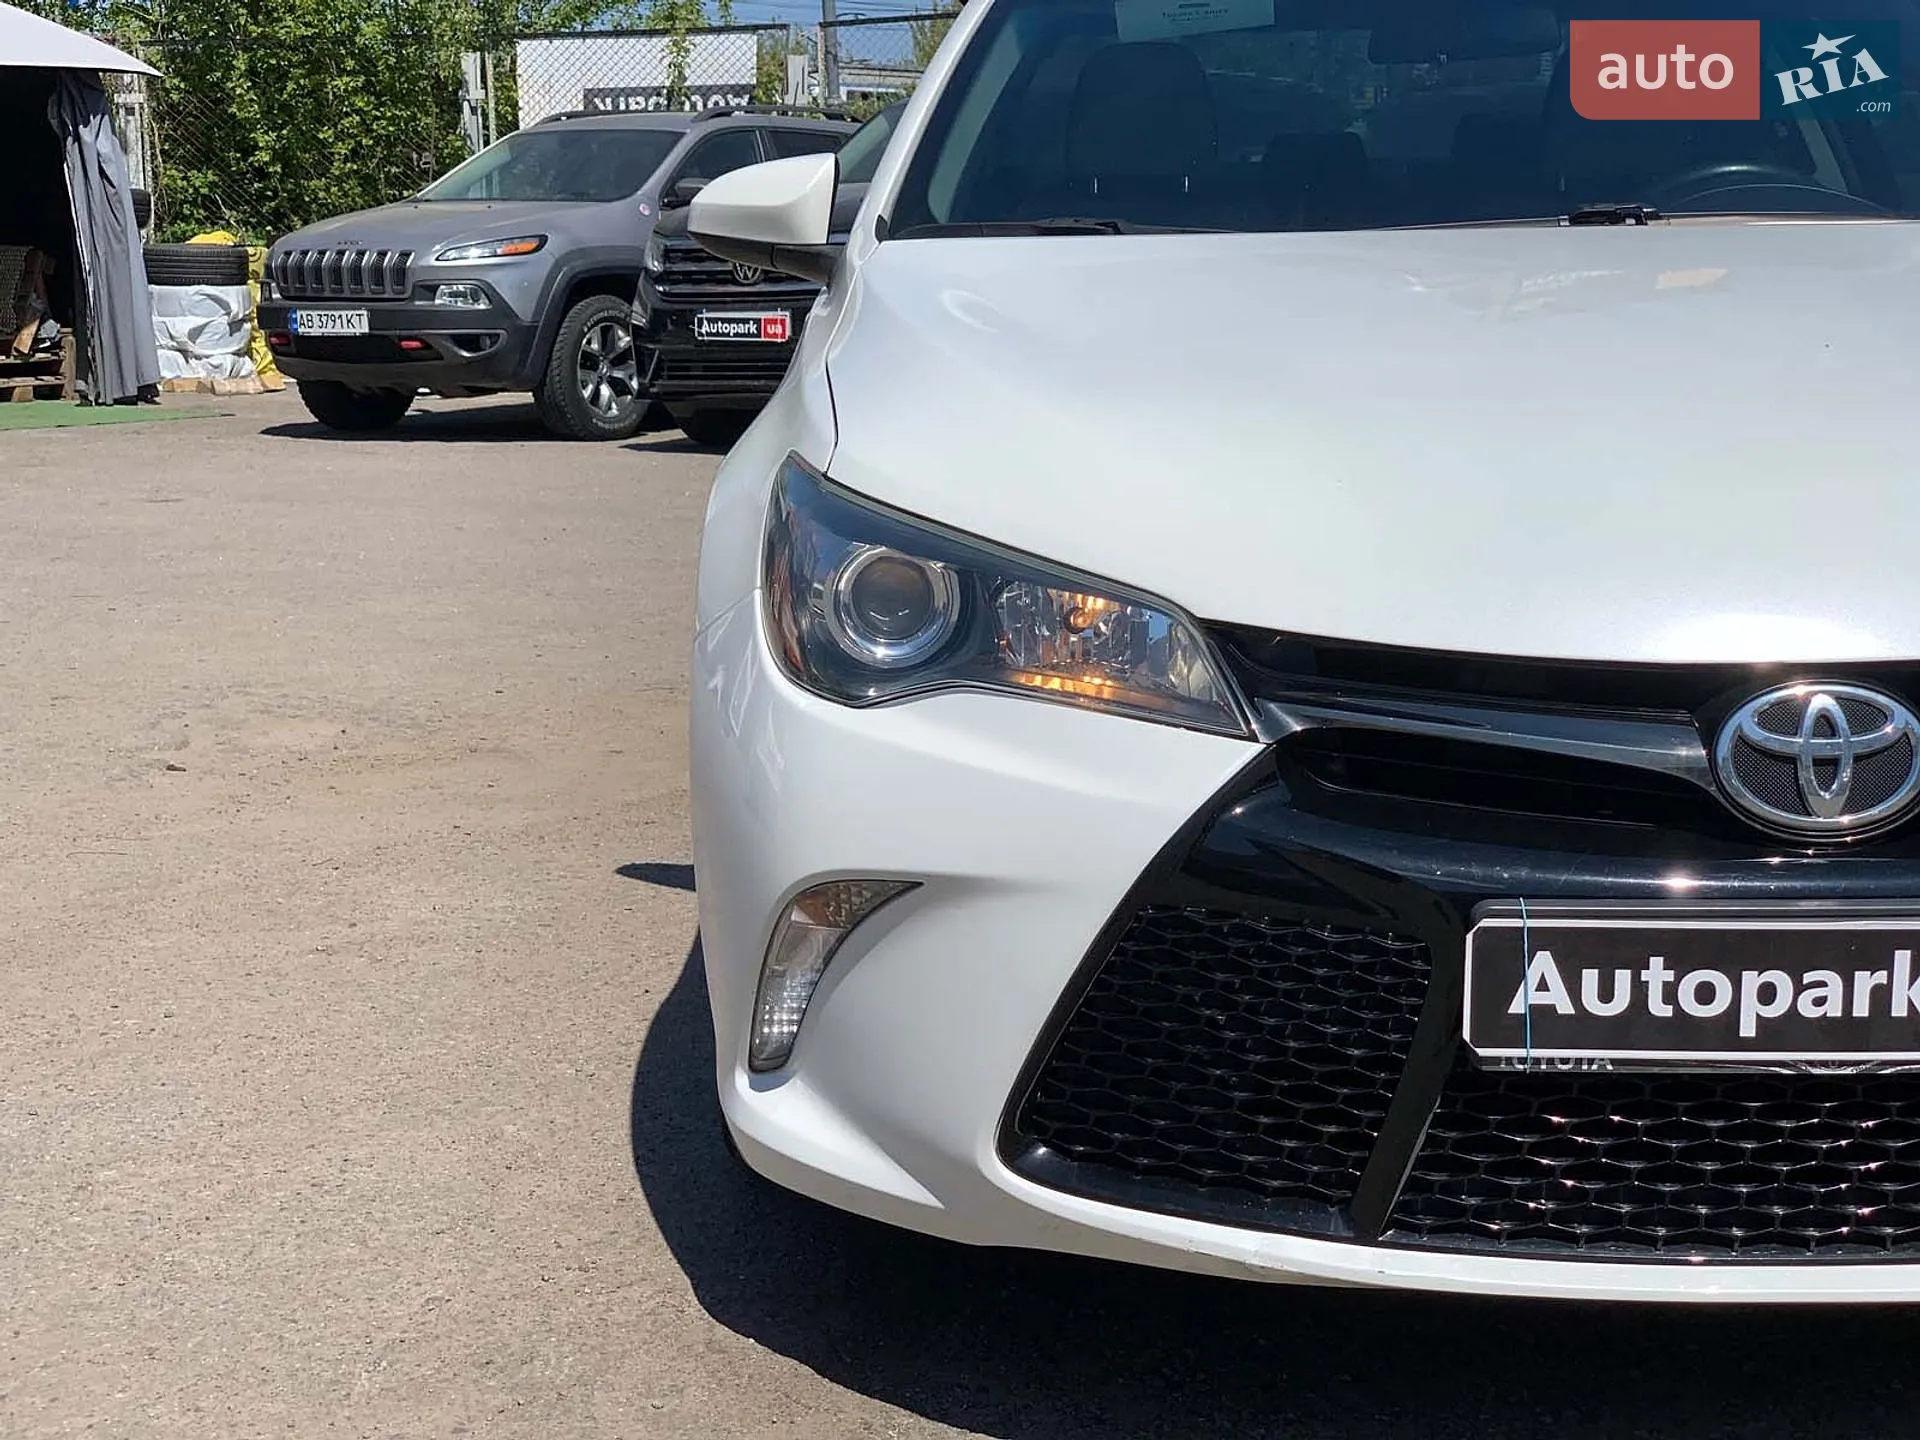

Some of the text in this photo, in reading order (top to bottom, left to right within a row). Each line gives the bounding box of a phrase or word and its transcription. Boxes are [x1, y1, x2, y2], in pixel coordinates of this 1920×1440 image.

[299, 313, 315, 329] AB
[318, 313, 344, 329] 3791
[345, 313, 365, 329] KT
[702, 320, 758, 337] Autopark
[1507, 949, 1920, 1038] Autopark
